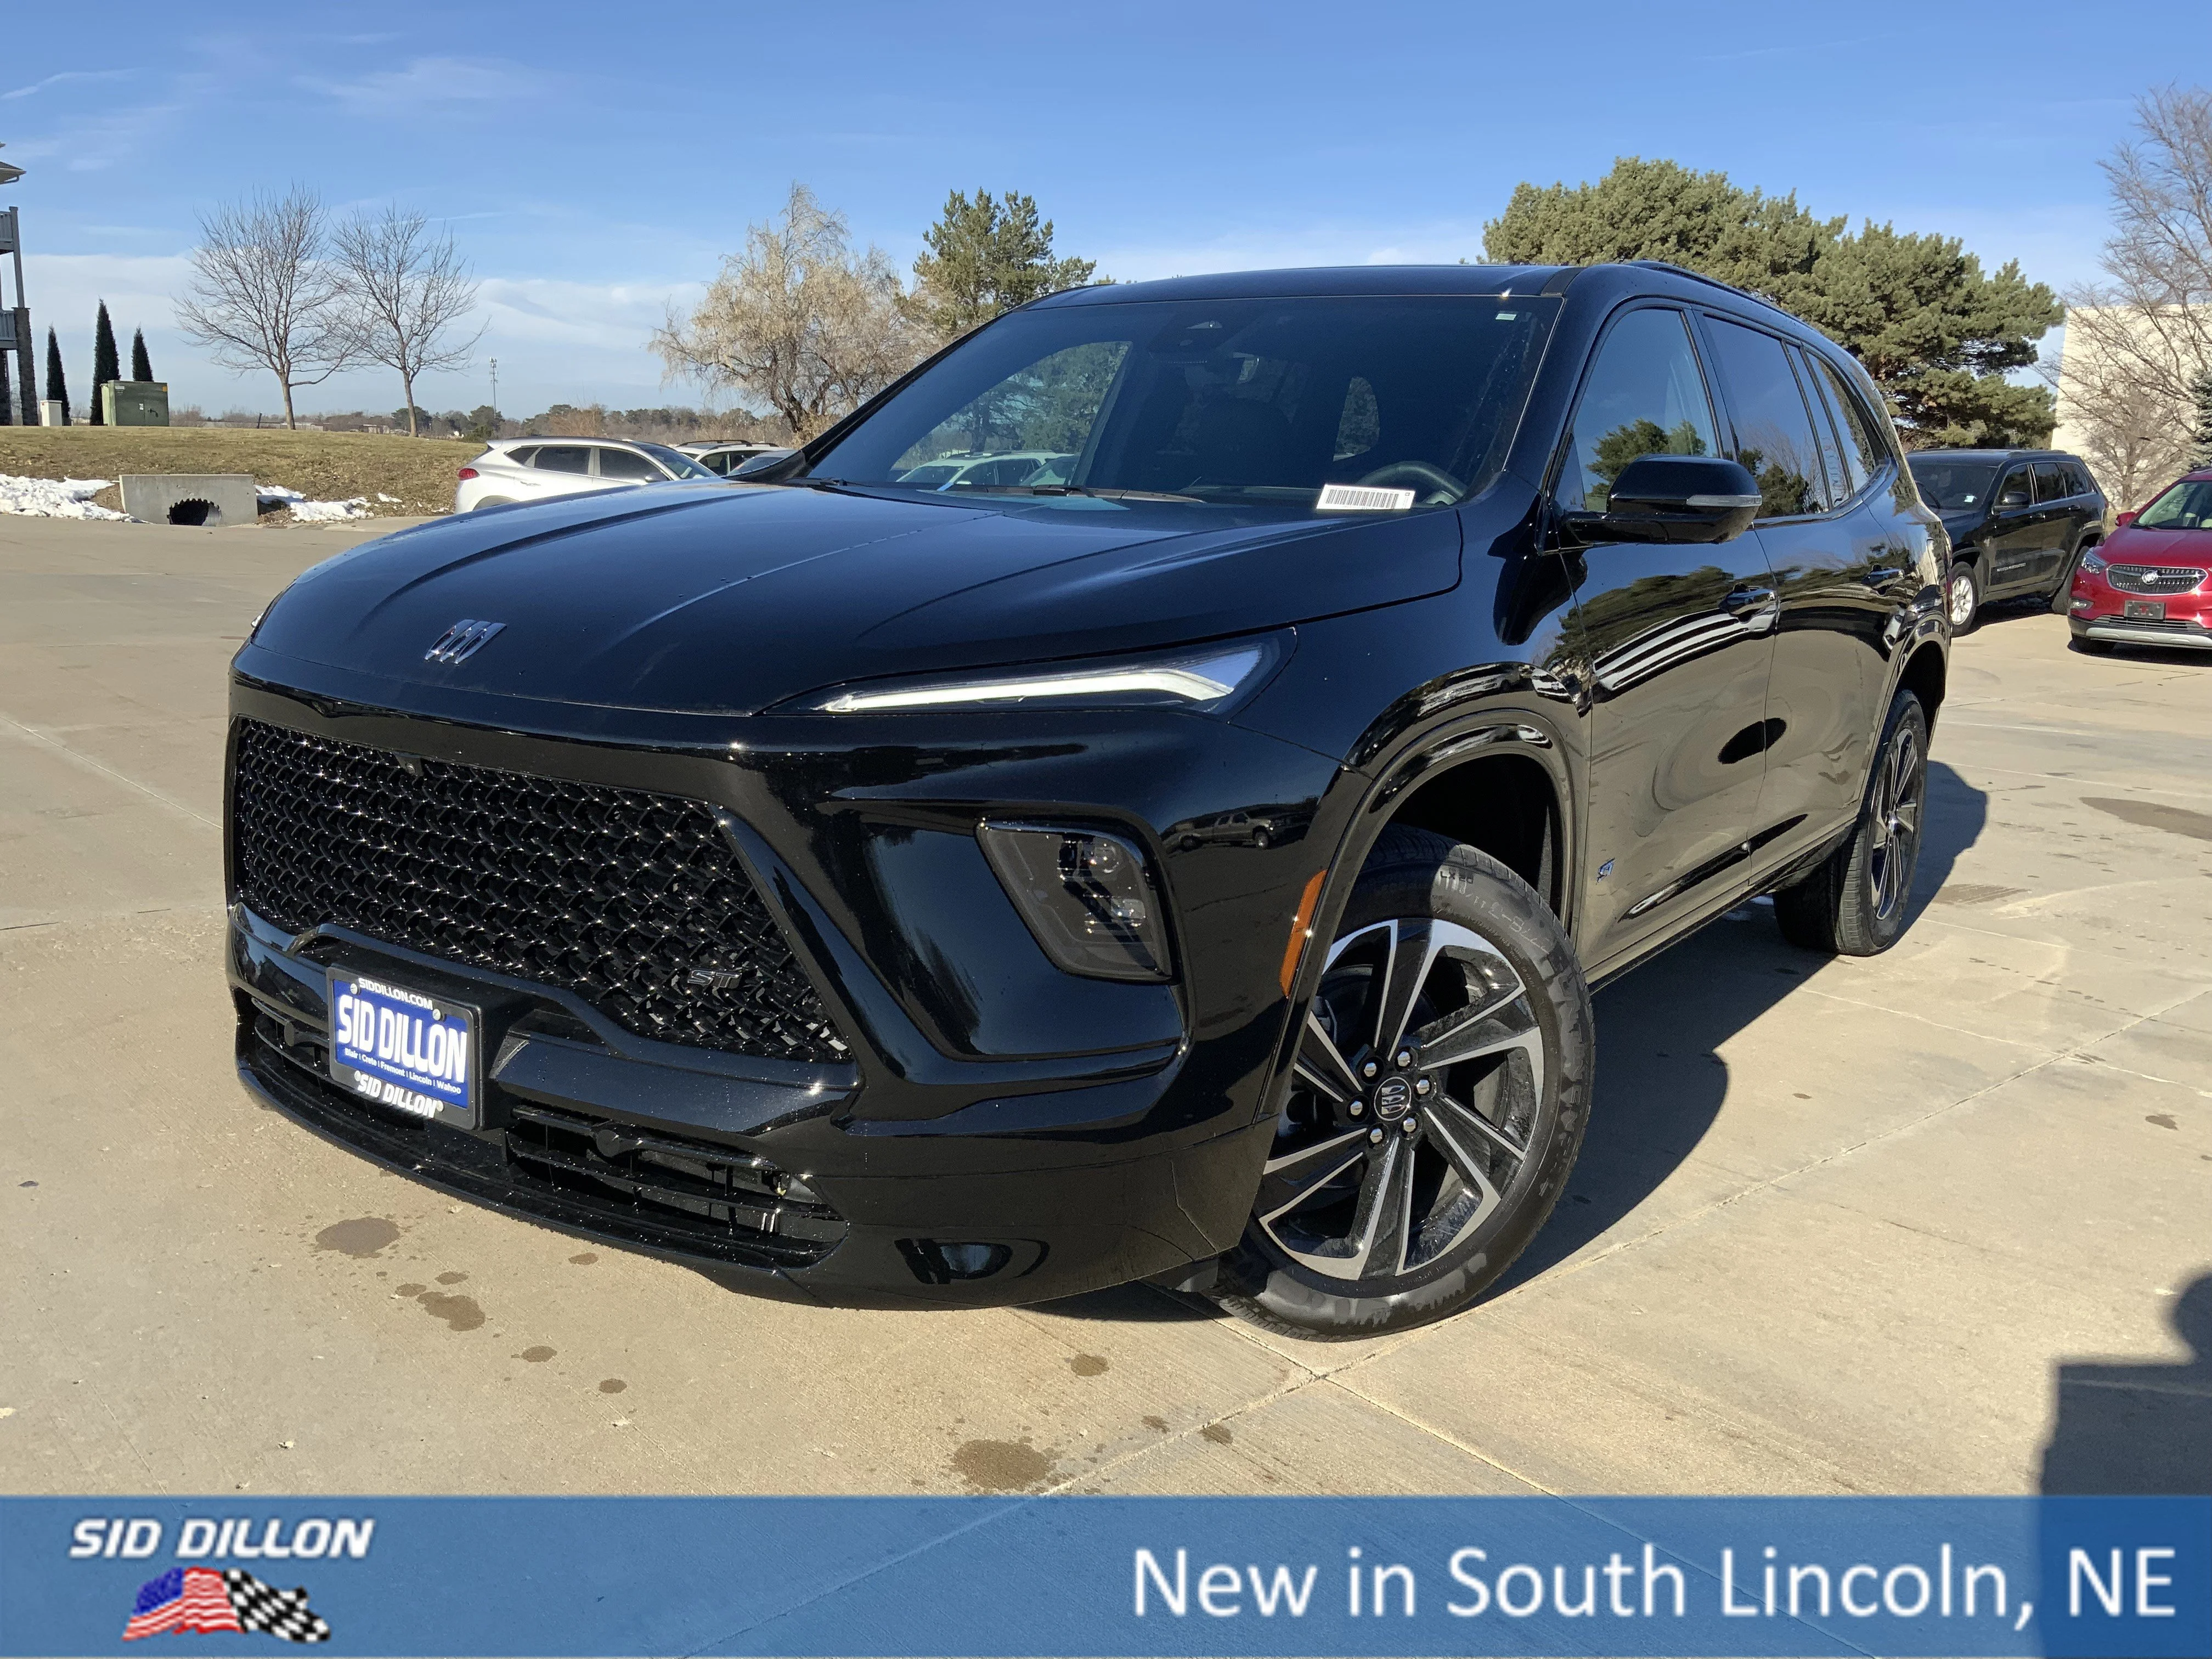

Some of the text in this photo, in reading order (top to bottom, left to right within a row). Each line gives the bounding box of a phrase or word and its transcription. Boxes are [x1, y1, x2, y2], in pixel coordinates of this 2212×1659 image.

[358, 978, 433, 1011] SIDDILLON.COM
[686, 969, 740, 988] ST
[338, 994, 467, 1084] SID DILLON
[345, 1047, 358, 1059] Blair
[362, 1054, 377, 1066] Crete
[380, 1060, 405, 1077] Fremont
[409, 1071, 432, 1086] Lincoln
[436, 1080, 461, 1094] Wahoo
[357, 1073, 438, 1118] SID DILLON
